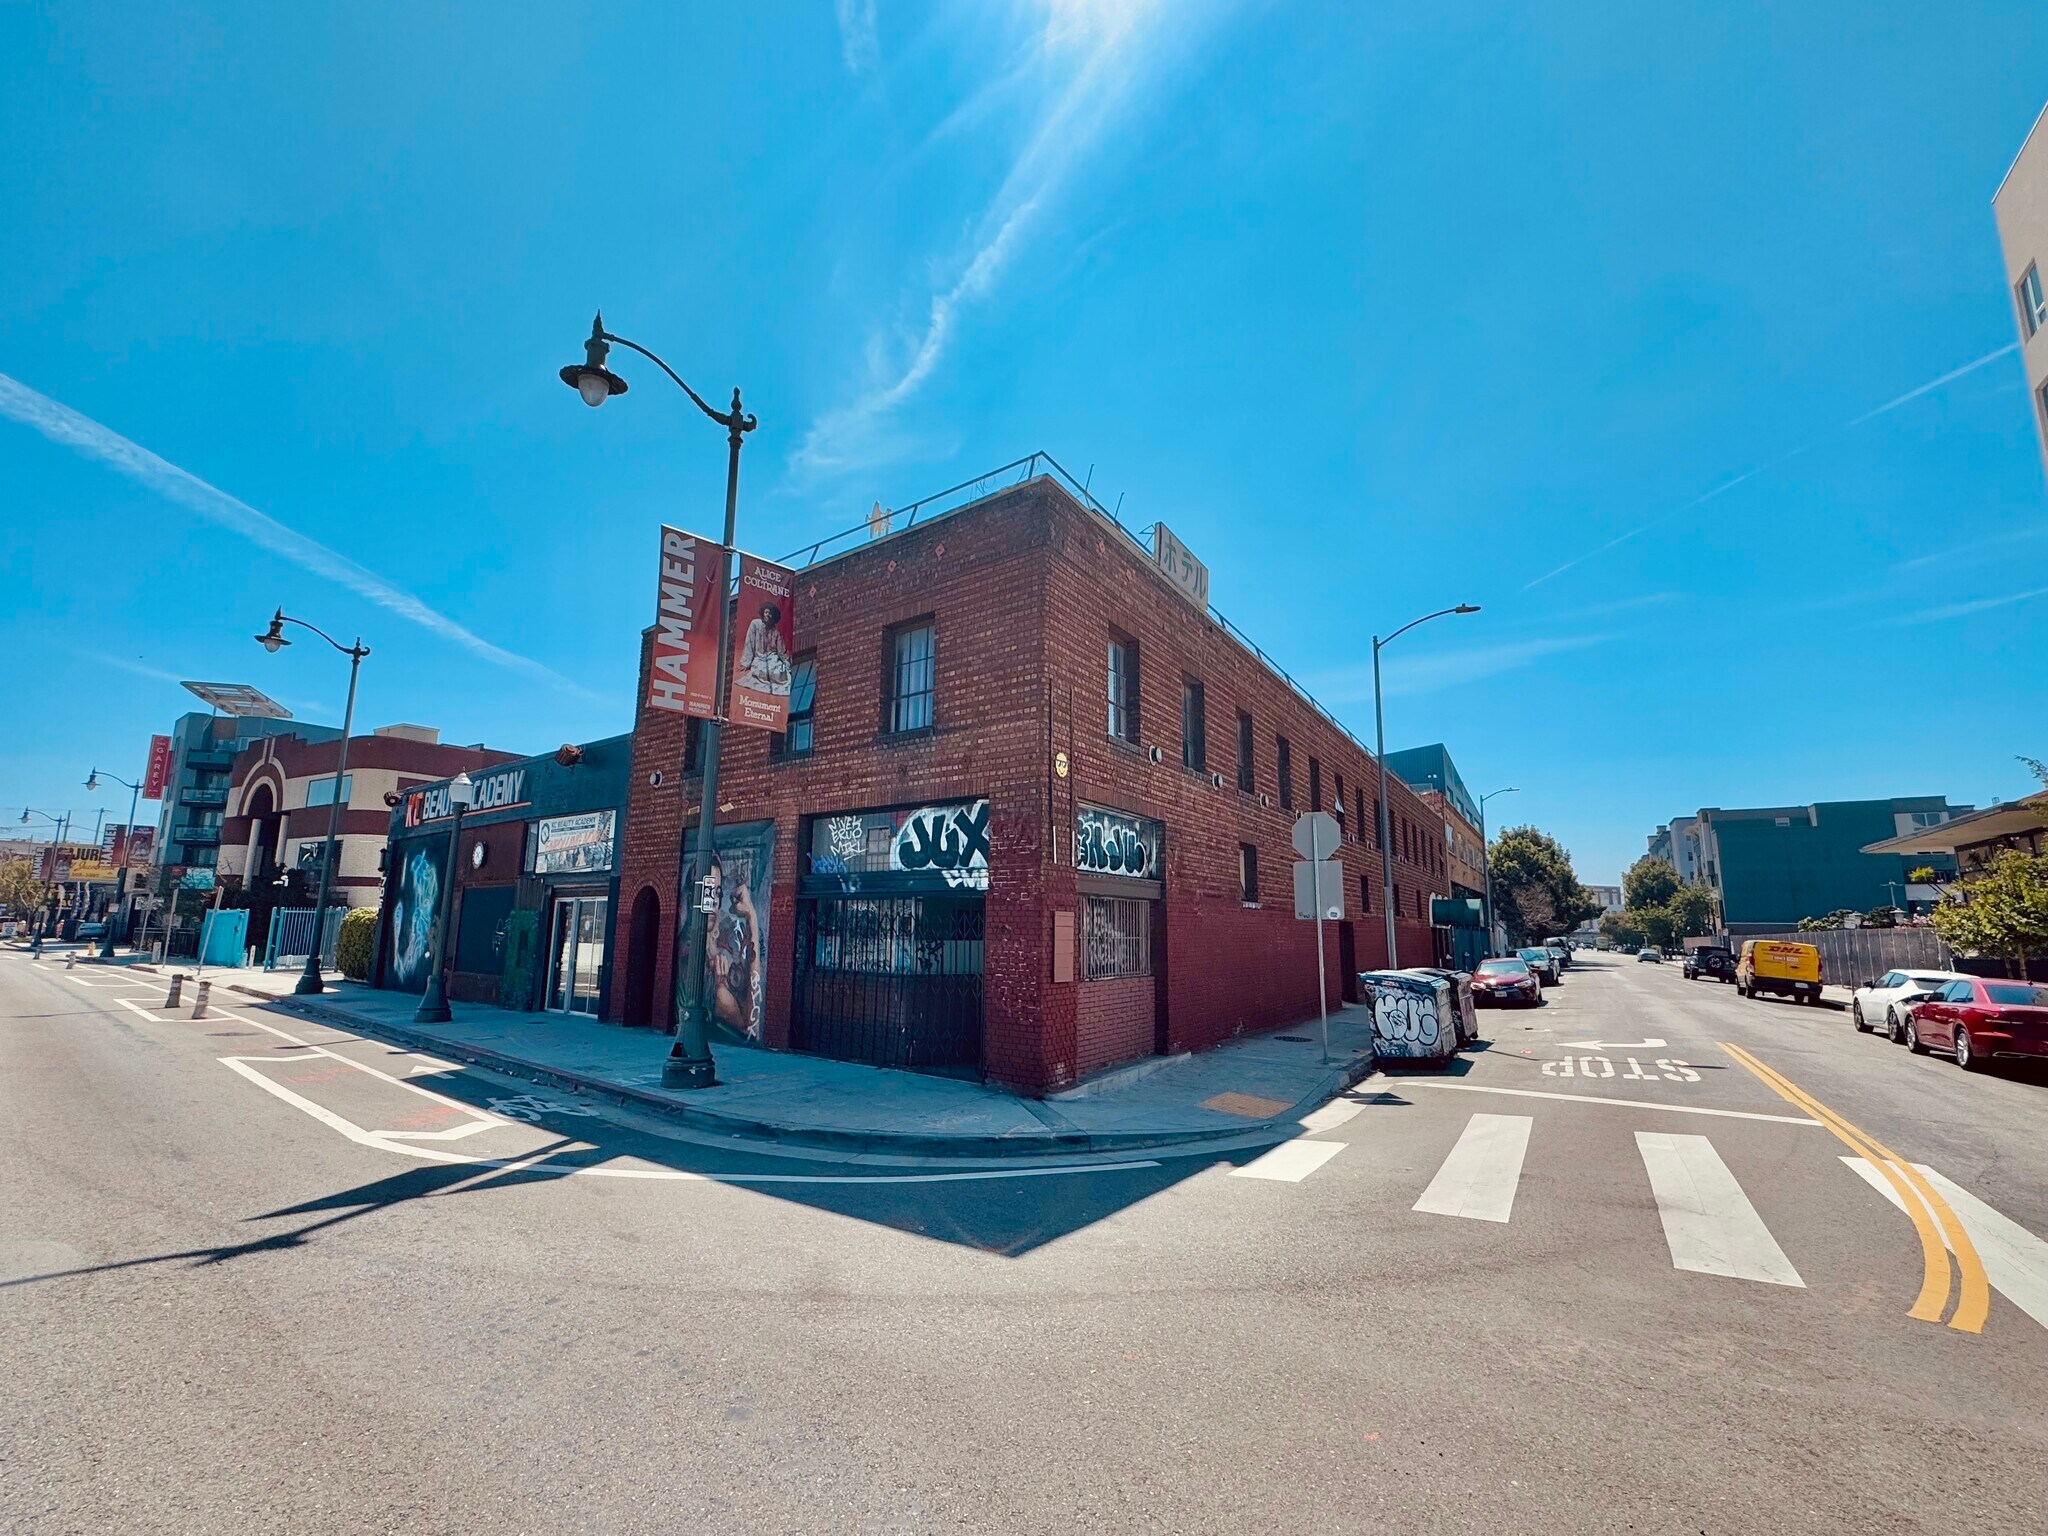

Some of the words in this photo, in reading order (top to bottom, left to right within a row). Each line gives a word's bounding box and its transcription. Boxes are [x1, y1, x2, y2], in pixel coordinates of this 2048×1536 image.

[754, 566, 782, 583] ALICE
[1163, 534, 1207, 599] ホテル
[744, 575, 790, 598] COLTRANE
[652, 532, 696, 711] HAMMER
[738, 694, 782, 713] Monument
[744, 707, 774, 722] Eternal
[151, 747, 165, 787] GAREY
[405, 791, 425, 828] KC
[422, 788, 455, 820] BEAU
[100, 824, 118, 867] HAMMER
[31, 847, 46, 880] HAMMER
[1768, 945, 1804, 954] DHL
[1541, 1055, 1702, 1083] STOP
